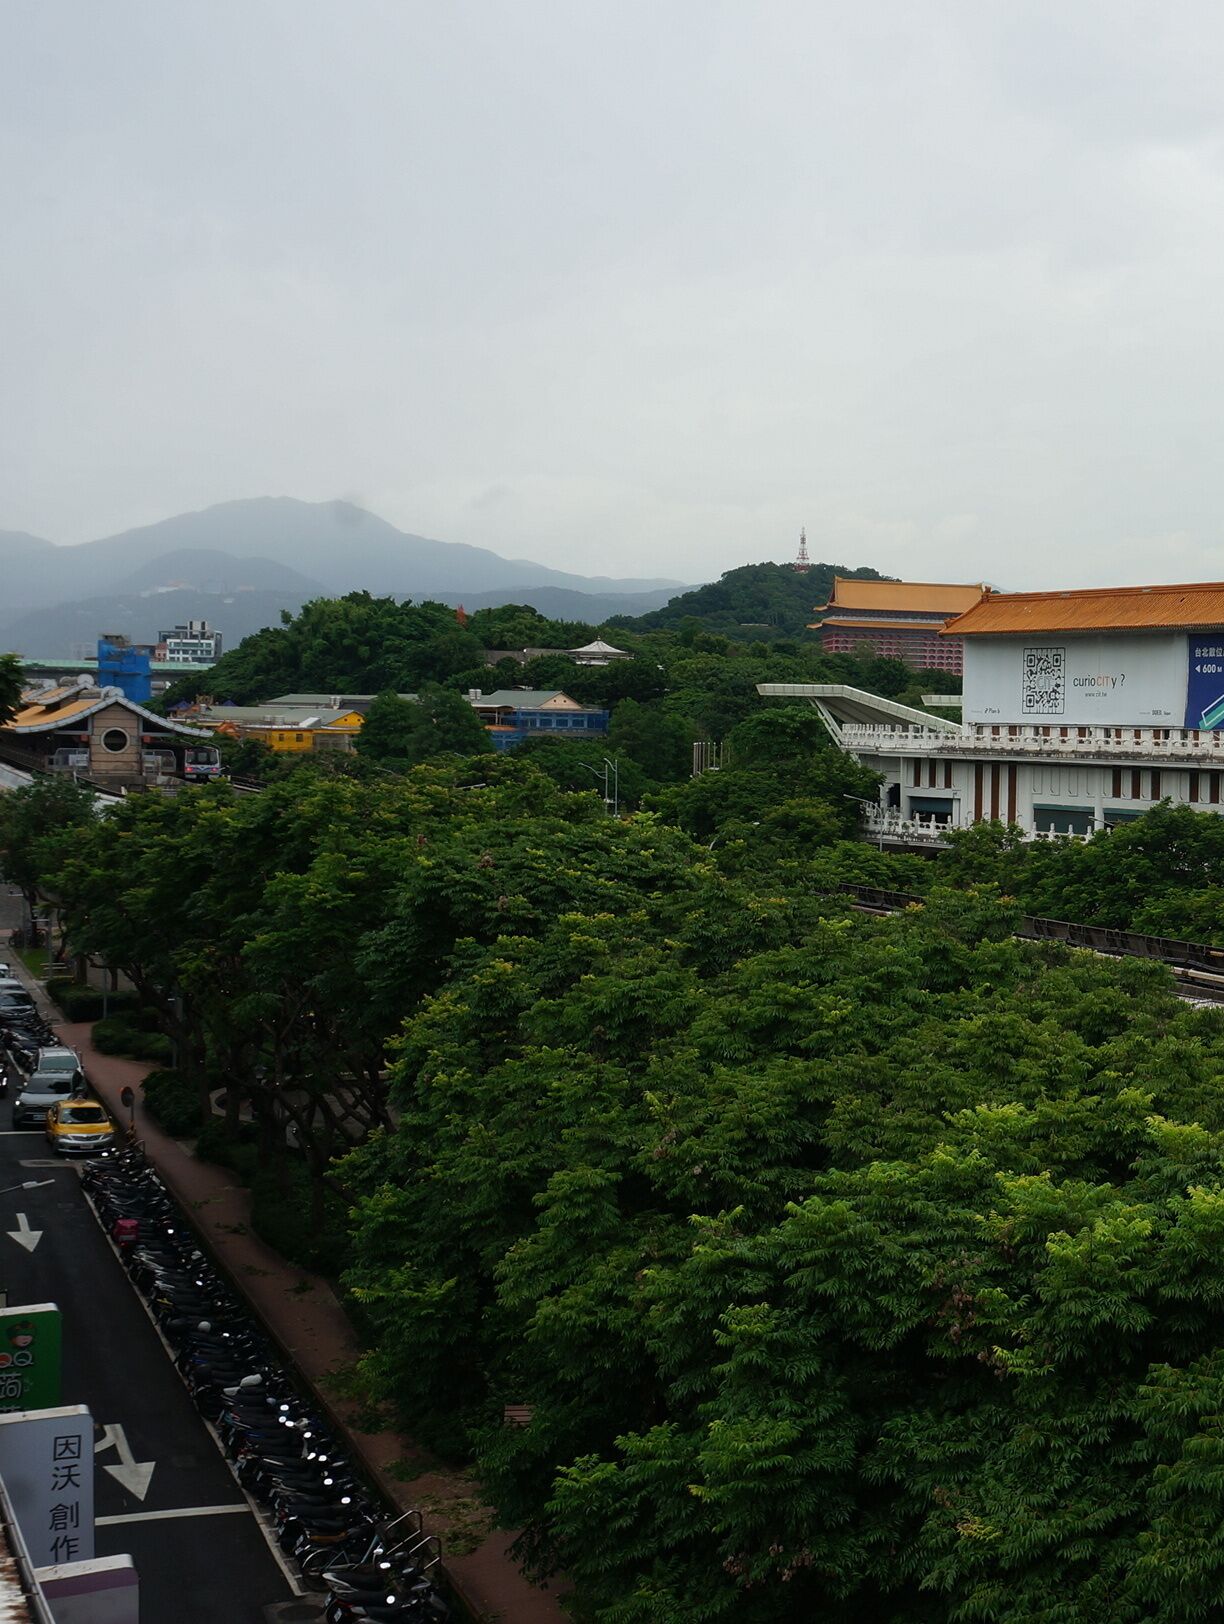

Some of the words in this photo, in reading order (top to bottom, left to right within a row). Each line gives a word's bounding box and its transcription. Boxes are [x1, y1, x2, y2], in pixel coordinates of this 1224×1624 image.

[1072, 674, 1117, 689] curioCITy
[1202, 664, 1217, 673] 600
[51, 1435, 81, 1491] 因沃
[49, 1502, 80, 1562] 創作
